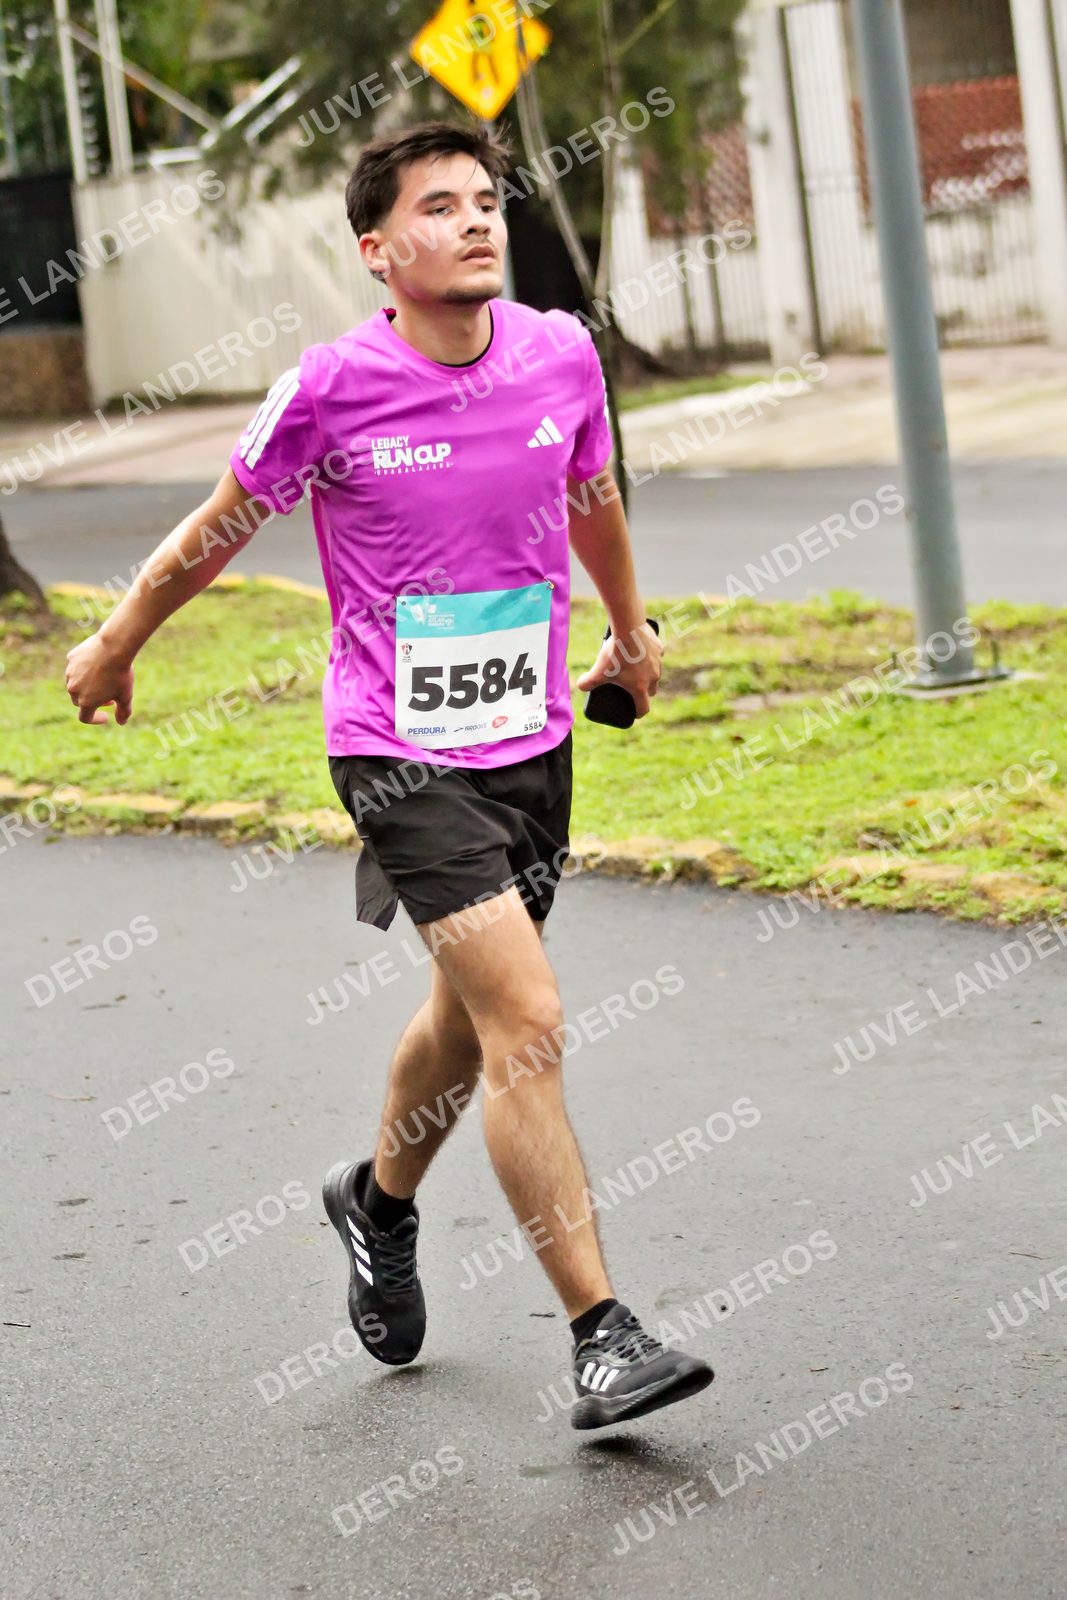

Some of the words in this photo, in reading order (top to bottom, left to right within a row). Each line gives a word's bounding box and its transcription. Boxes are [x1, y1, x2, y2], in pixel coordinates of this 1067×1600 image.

[371, 435, 409, 450] LEGACY
[372, 447, 413, 470] RUN
[413, 442, 452, 465] CUP
[408, 652, 537, 712] 5584
[407, 726, 446, 735] PERDURA
[524, 721, 542, 731] 5584
